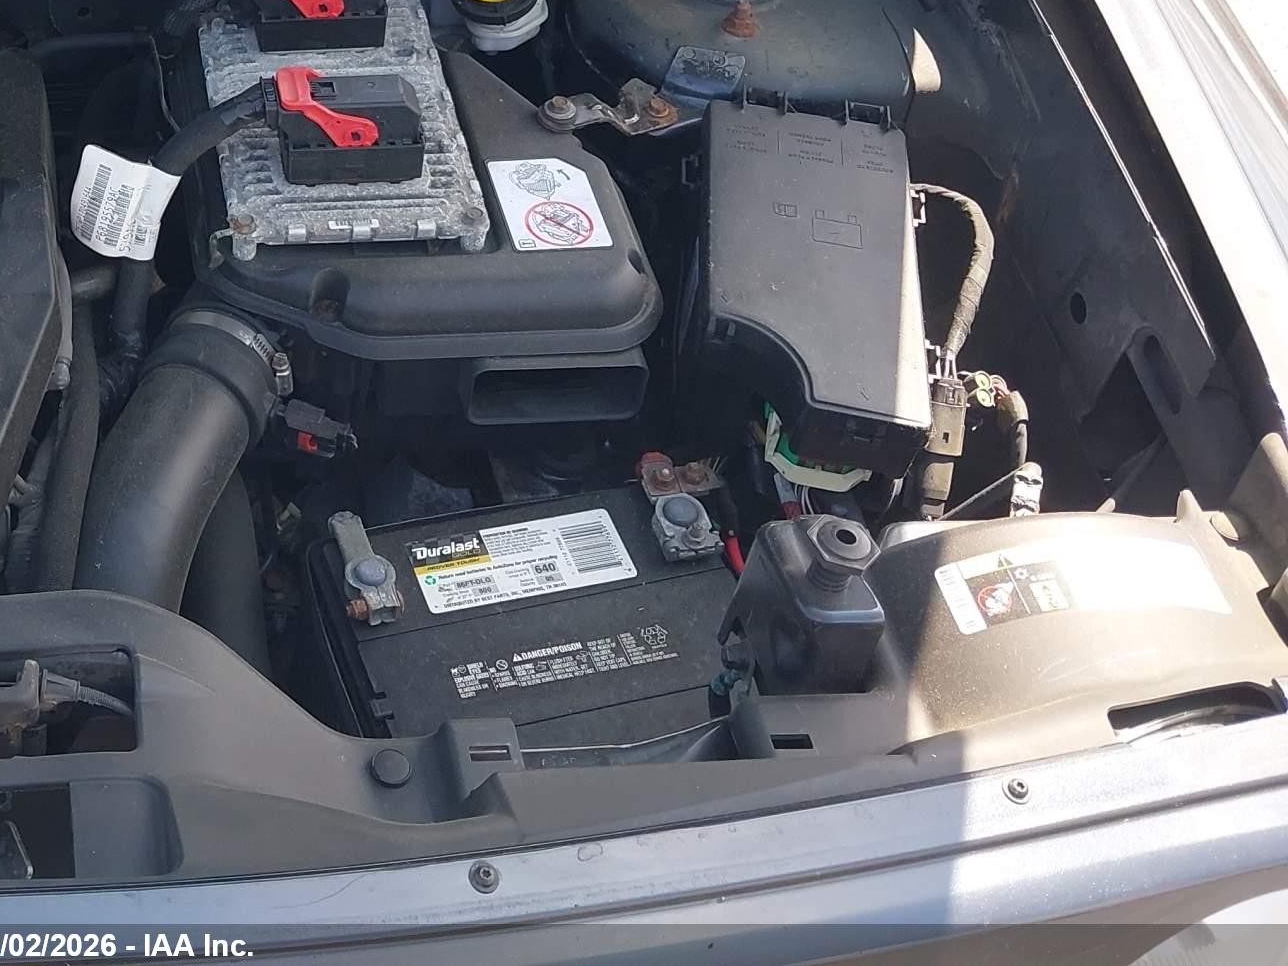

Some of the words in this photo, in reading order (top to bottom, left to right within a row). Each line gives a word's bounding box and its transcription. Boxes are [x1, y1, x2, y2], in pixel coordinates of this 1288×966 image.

[411, 538, 481, 560] Duralast
[534, 562, 556, 574] 640
[521, 642, 583, 660] DANGER/POISON
